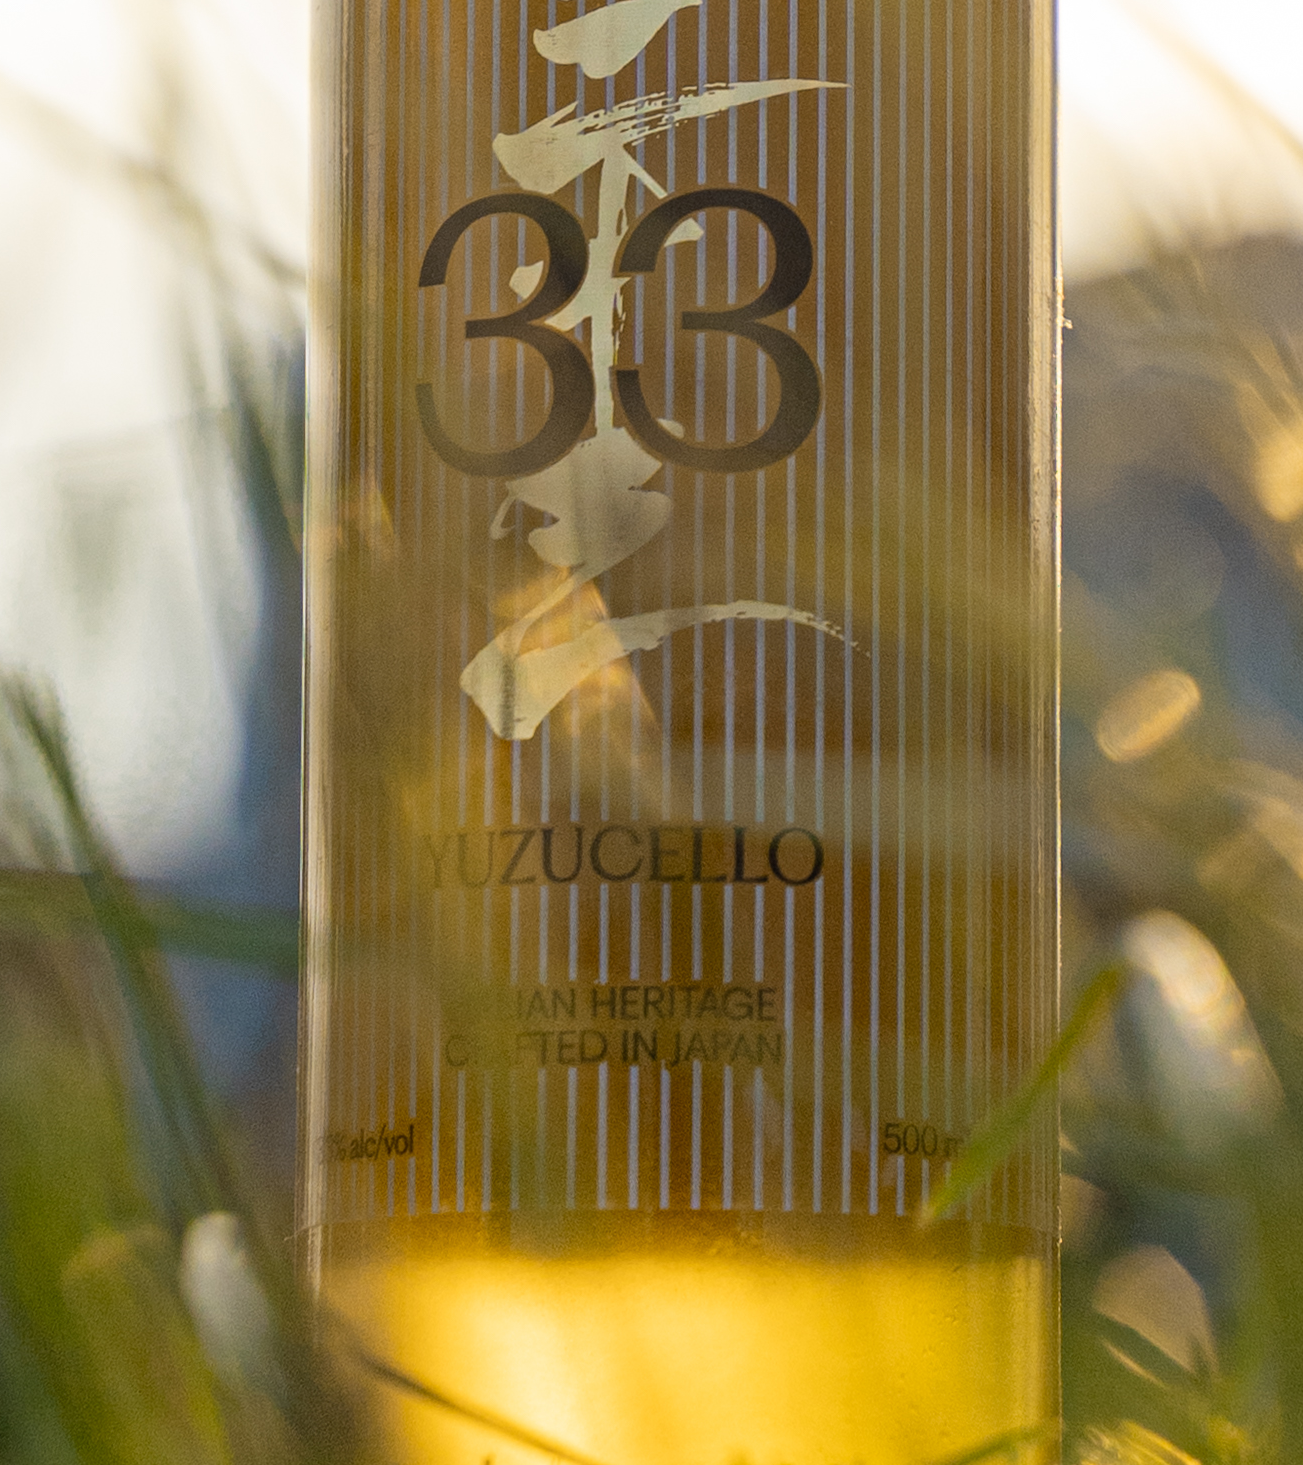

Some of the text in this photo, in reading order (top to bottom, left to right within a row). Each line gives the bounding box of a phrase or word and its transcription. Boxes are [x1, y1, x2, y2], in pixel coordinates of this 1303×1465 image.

[414, 187, 824, 480] 33
[419, 824, 825, 888] YUZUCELLO
[592, 984, 777, 1021] HERITAGE
[446, 1028, 784, 1068] CFTED IN JAPAN
[883, 1122, 939, 1157] 500
